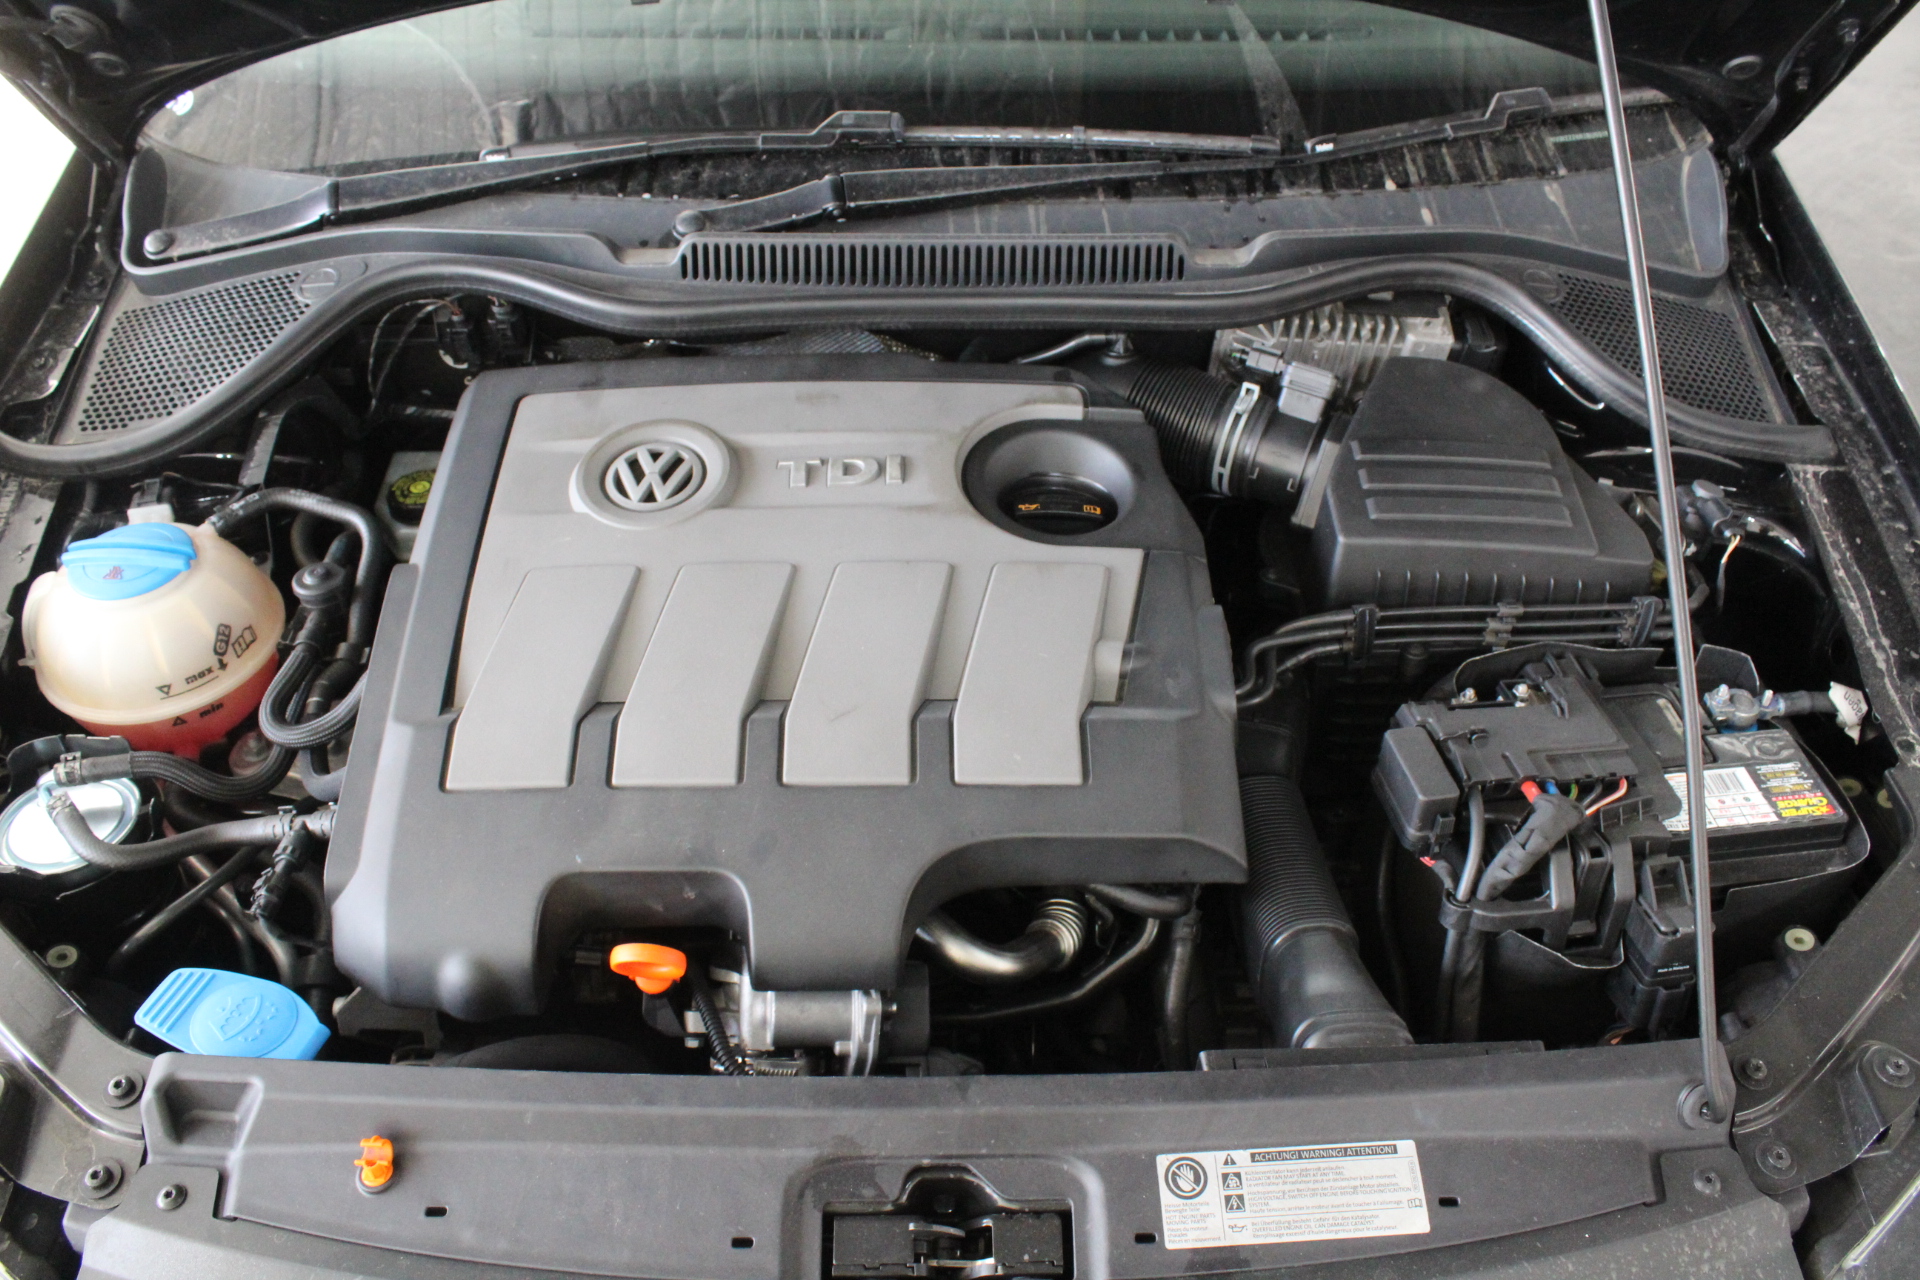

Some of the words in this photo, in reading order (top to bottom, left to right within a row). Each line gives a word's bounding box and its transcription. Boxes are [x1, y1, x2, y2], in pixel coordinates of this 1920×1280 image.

[776, 454, 906, 488] TDI
[215, 625, 231, 654] G12
[185, 666, 214, 685] max
[199, 702, 224, 718] min
[1777, 796, 1828, 809] CHARGE
[1781, 806, 1822, 817] SUPER
[1254, 1152, 1299, 1161] ACHTUNG!
[1301, 1148, 1345, 1158] WARNING!
[1347, 1146, 1395, 1156] ATTENTION!
